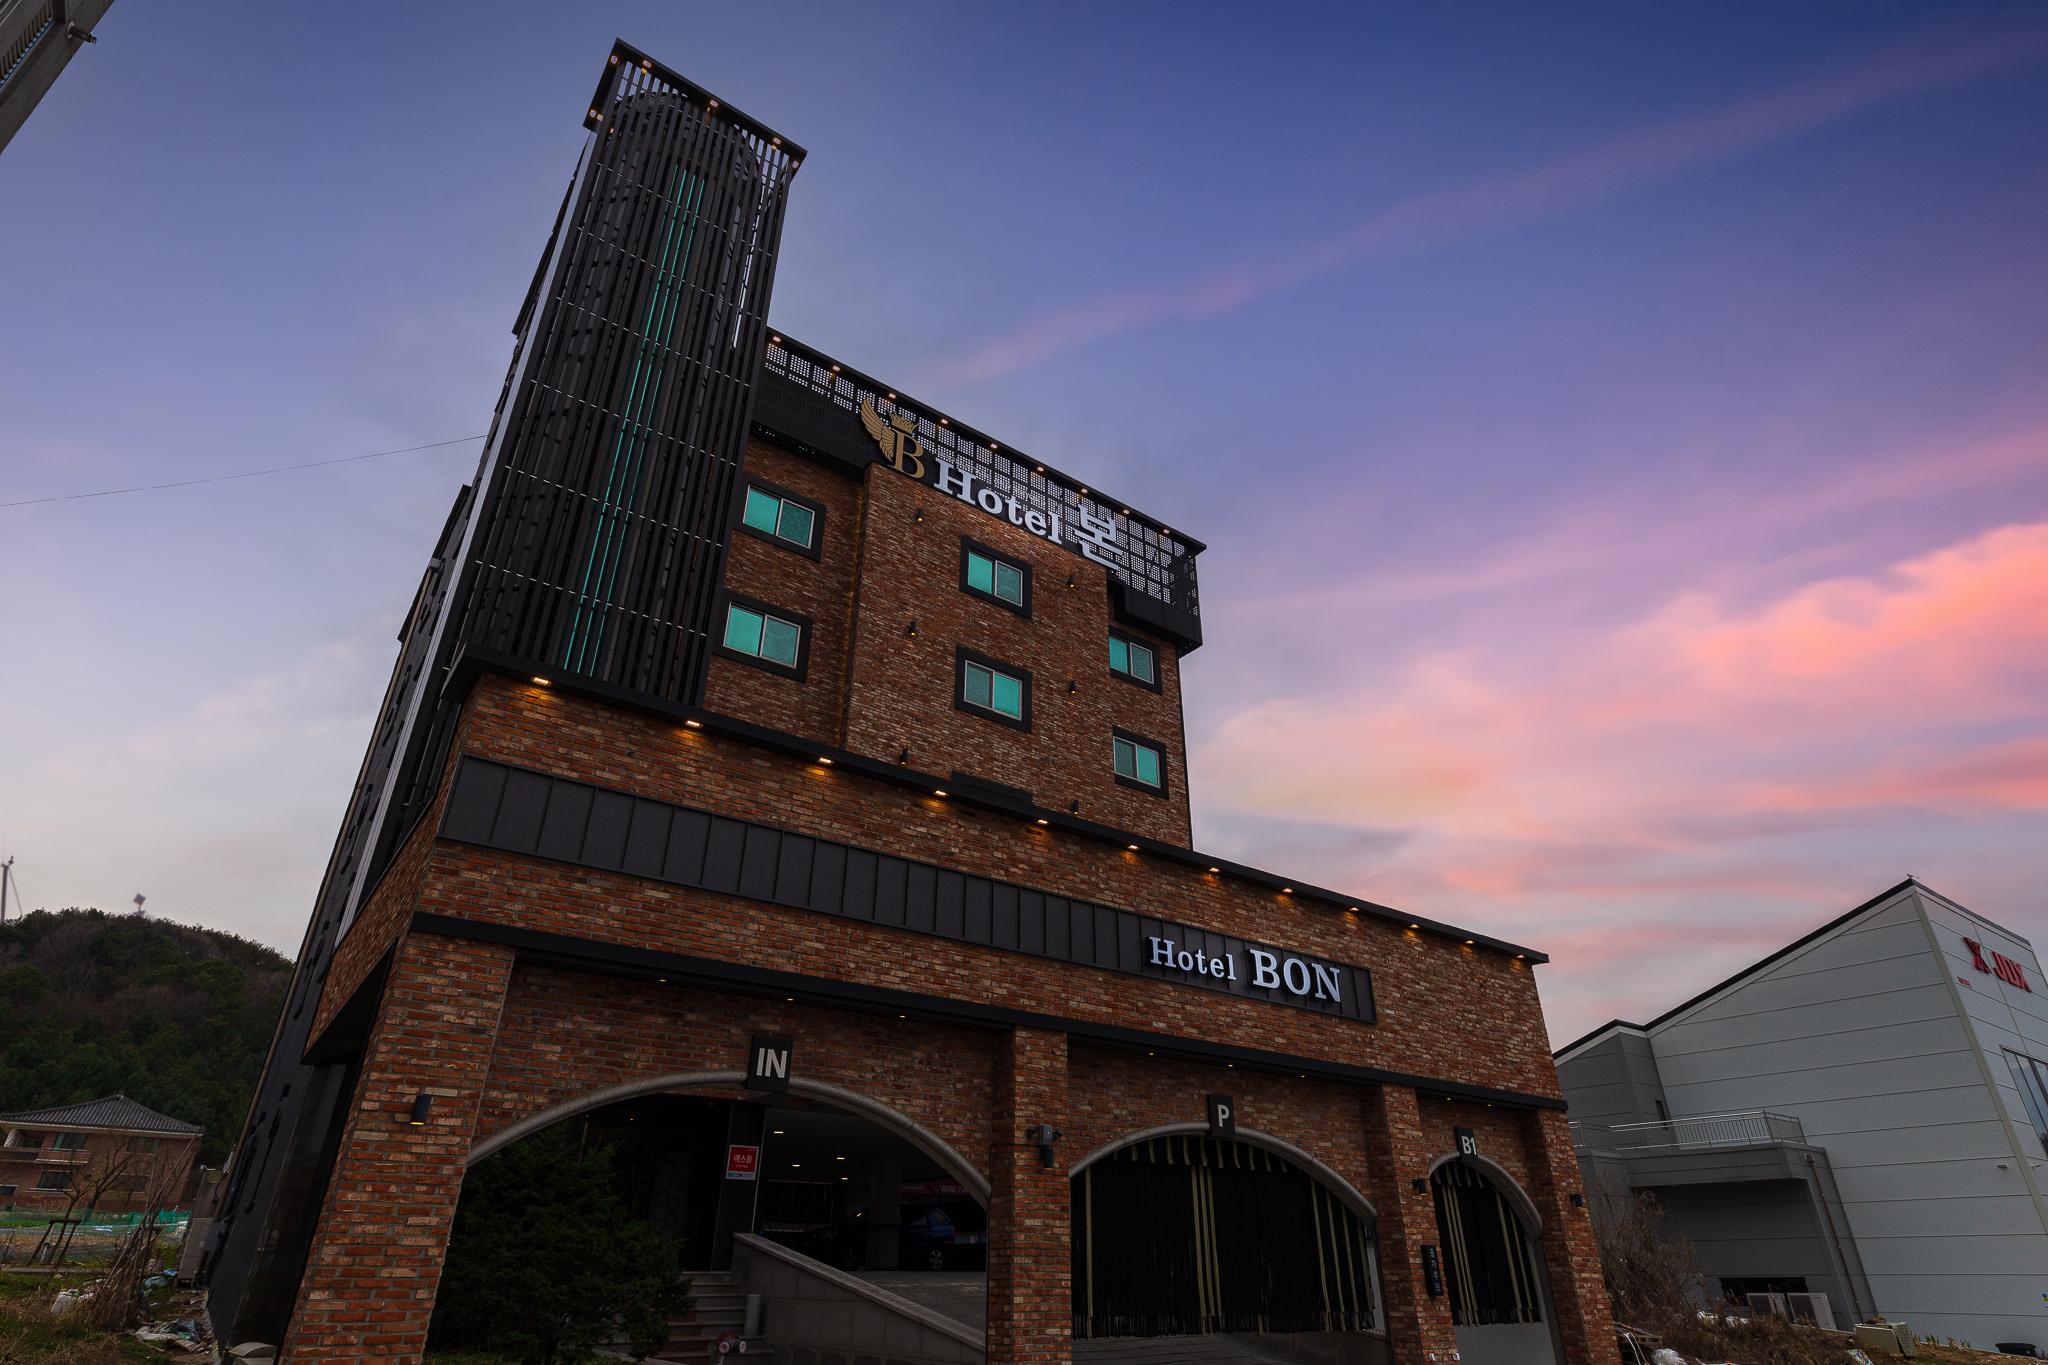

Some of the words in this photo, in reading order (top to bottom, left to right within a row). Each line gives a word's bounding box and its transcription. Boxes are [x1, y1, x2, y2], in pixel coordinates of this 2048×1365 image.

[892, 427, 925, 479] B
[934, 456, 1063, 545] Hotel
[1073, 504, 1123, 571] 본
[1149, 936, 1237, 981] Hotel
[1250, 948, 1341, 1003] BON
[756, 1047, 788, 1079] IN
[1217, 1104, 1230, 1128] P
[1461, 1135, 1477, 1155] B1
